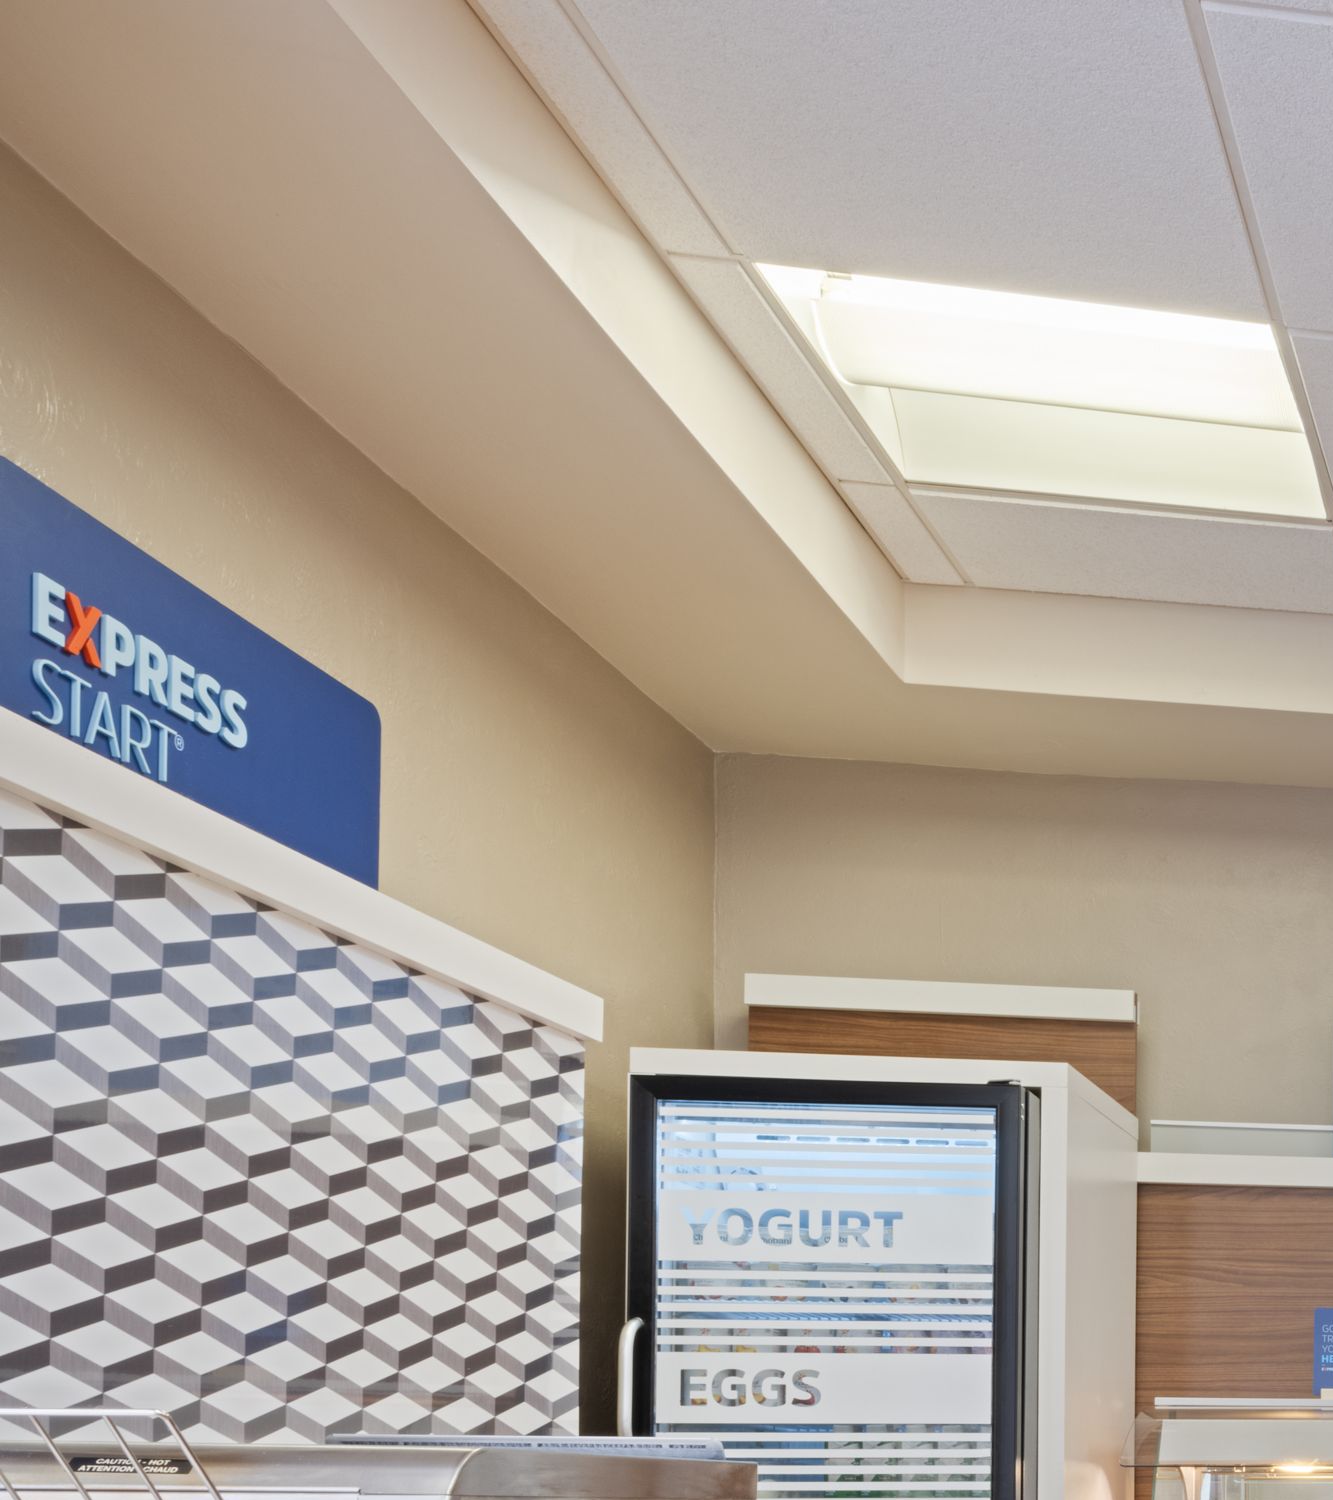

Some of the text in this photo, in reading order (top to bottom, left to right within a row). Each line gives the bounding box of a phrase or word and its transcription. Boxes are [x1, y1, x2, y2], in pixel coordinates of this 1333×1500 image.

[32, 572, 248, 749] EXPRESS
[680, 1207, 903, 1248] YOGURT
[680, 1369, 821, 1407] EGGS
[77, 1465, 178, 1474] ATTENTION CHAUD
[95, 1458, 142, 1466] CAUTIO
